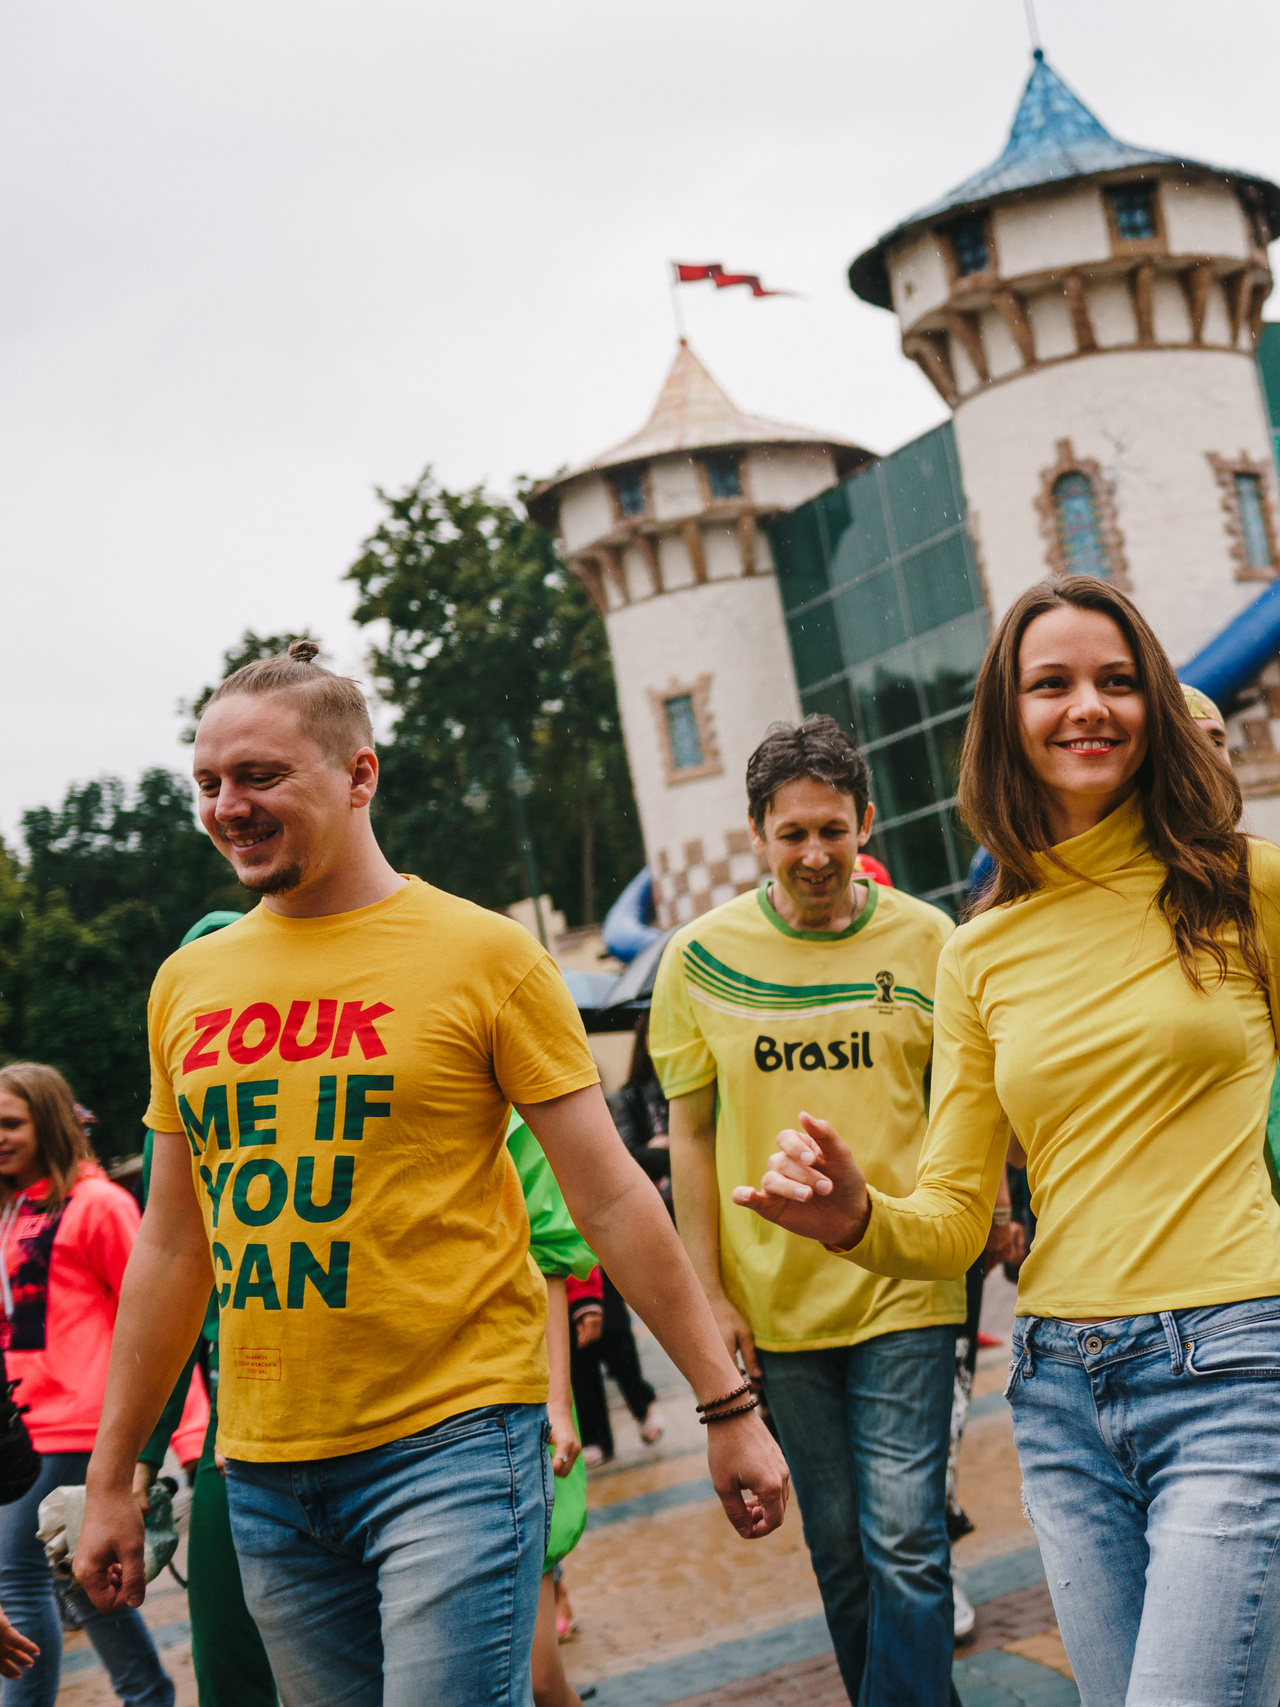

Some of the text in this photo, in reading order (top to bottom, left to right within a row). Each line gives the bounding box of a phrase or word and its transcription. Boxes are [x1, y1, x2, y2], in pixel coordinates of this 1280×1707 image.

[183, 999, 394, 1075] ZOUK
[754, 1031, 873, 1072] Brasil
[178, 1075, 394, 1156] ME IF
[200, 1155, 354, 1228] YOU
[212, 1241, 350, 1310] CAN
